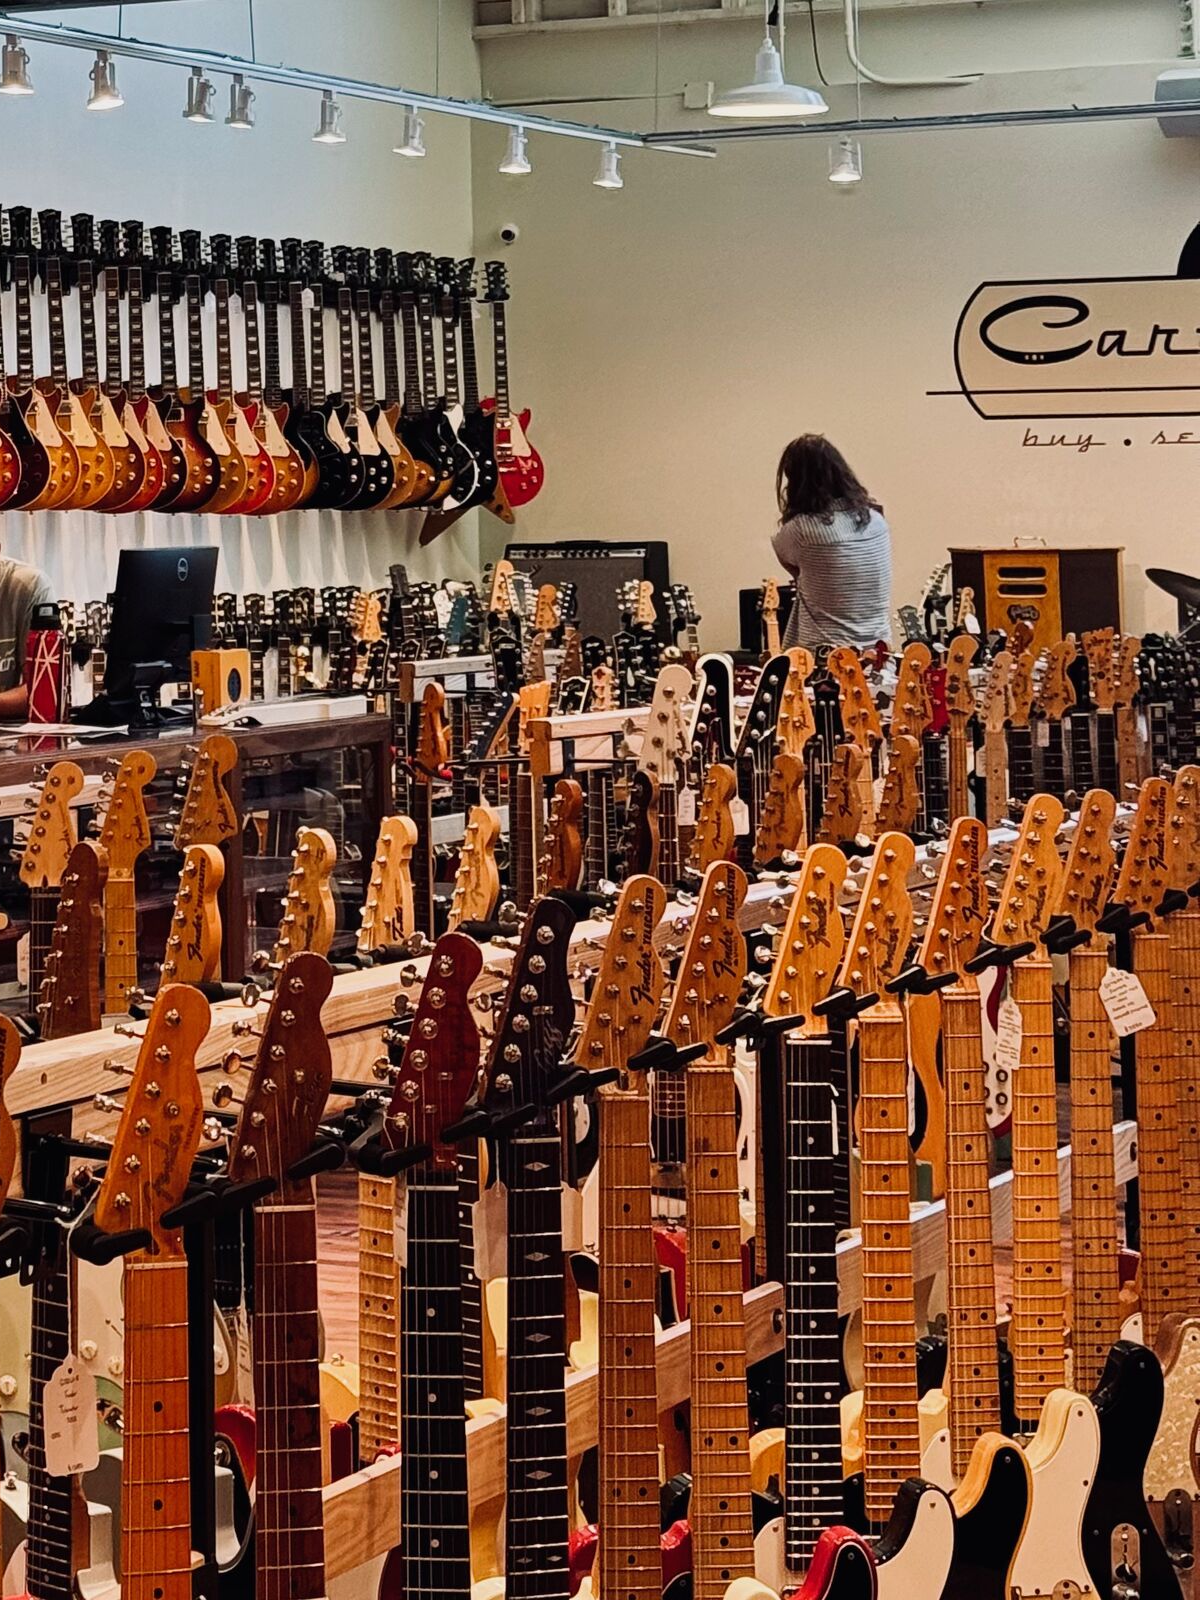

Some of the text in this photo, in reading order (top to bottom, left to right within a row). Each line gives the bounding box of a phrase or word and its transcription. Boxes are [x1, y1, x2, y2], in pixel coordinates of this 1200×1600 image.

[979, 295, 1200, 365] Car
[1022, 428, 1106, 452] buy
[1149, 827, 1169, 873] Fender
[712, 866, 738, 979] Fender TELECASTER
[961, 871, 983, 924] Fender
[187, 914, 204, 961] Fender
[630, 886, 656, 1006] Fender TELECASTER
[143, 1123, 184, 1209] Fender
